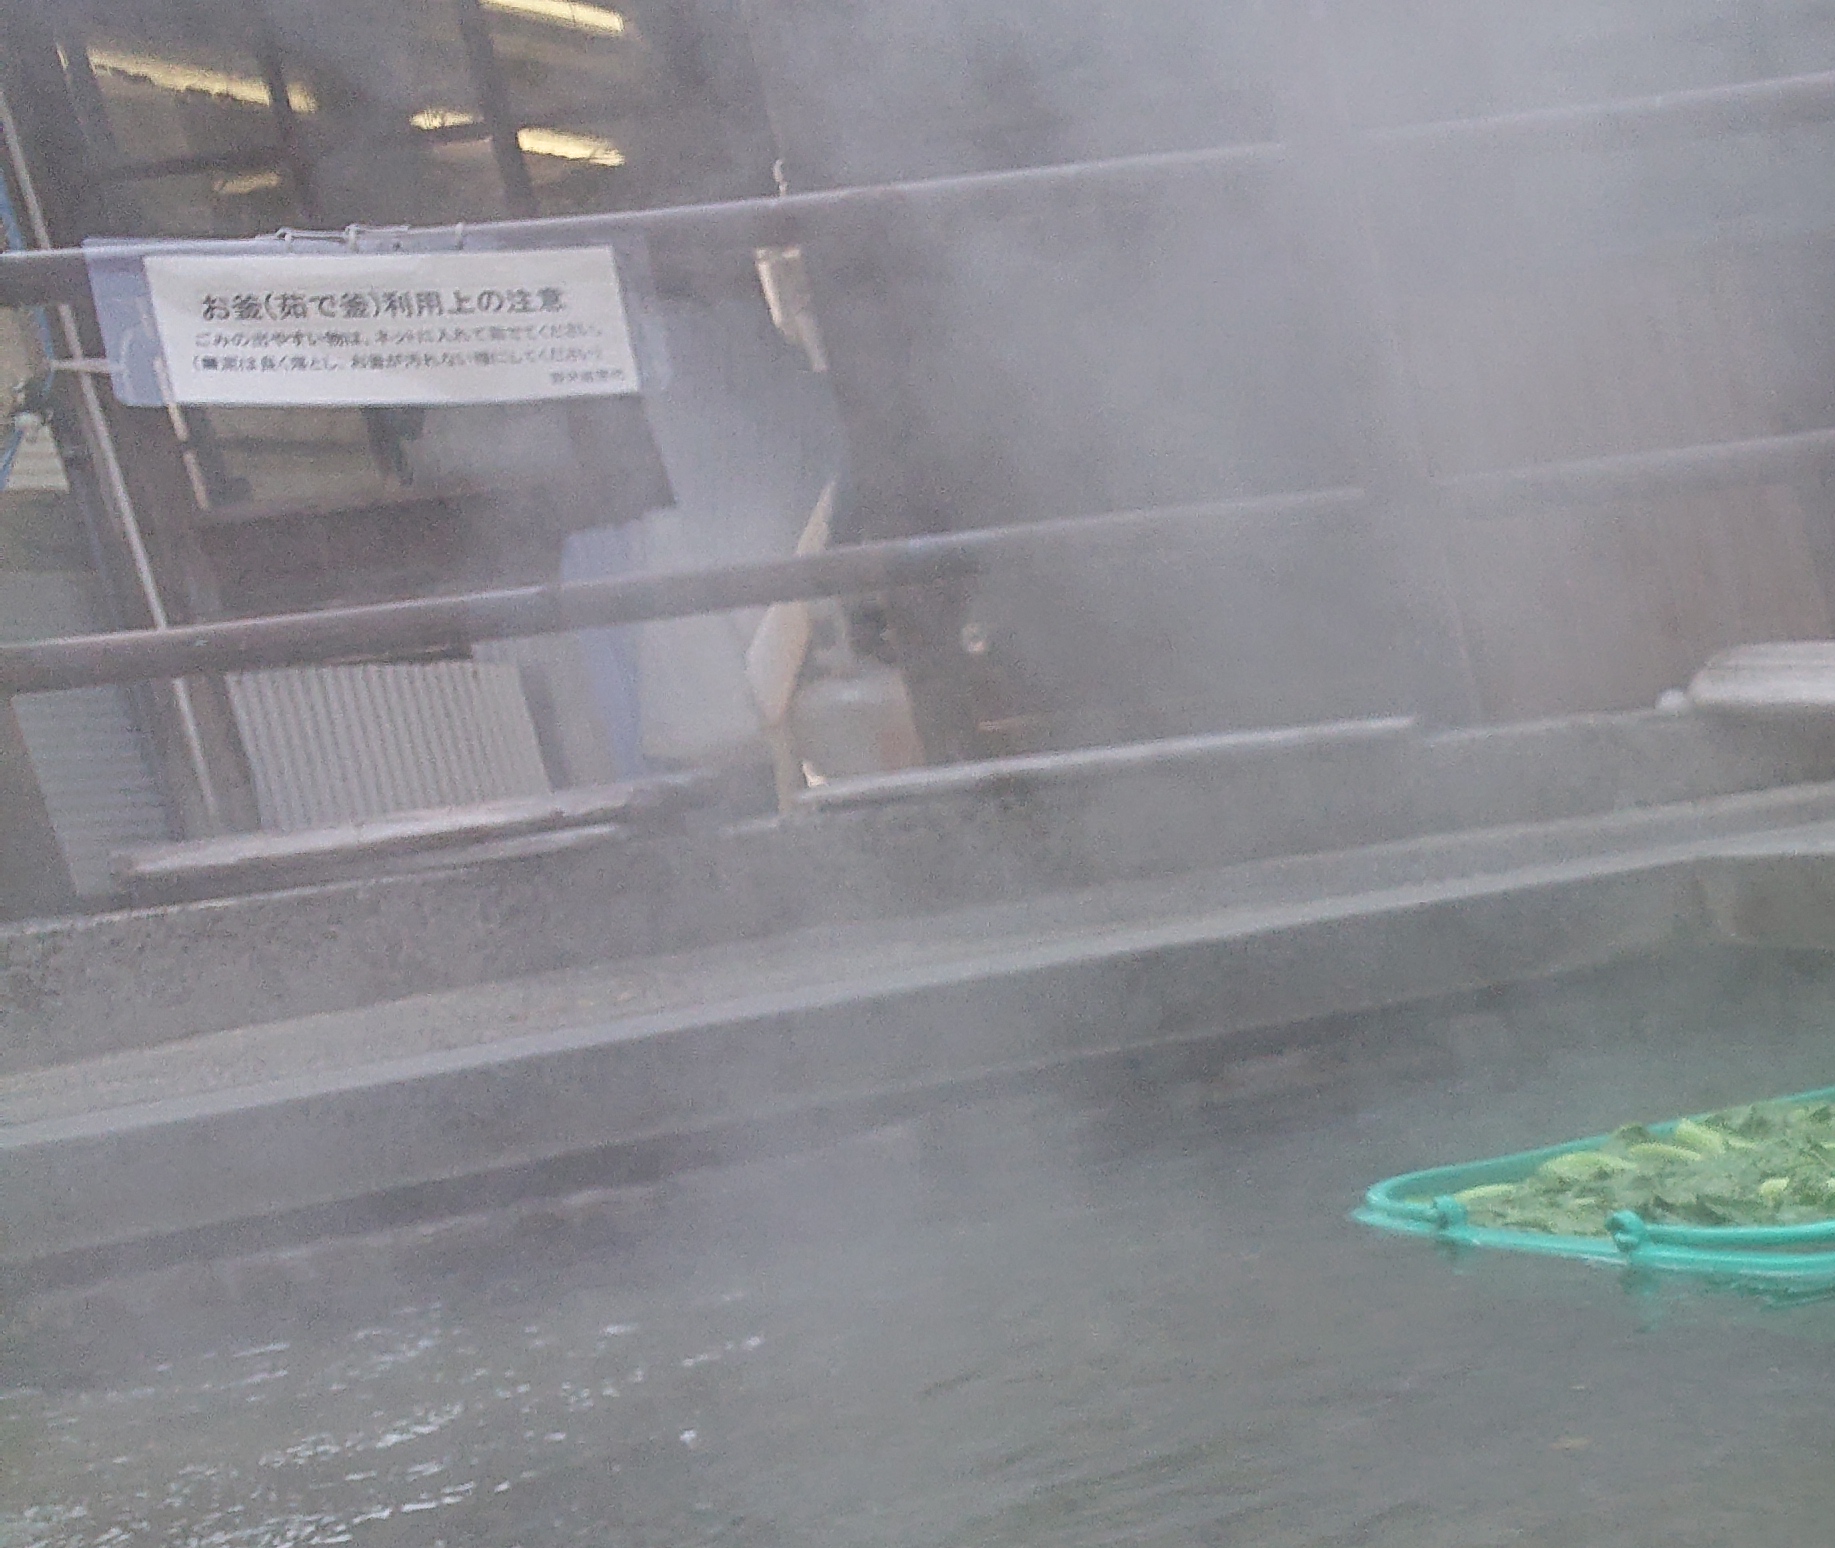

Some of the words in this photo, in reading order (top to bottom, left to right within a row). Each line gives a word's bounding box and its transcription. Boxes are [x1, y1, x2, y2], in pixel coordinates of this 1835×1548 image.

[202, 286, 565, 321] お釜(茹で釜)利用上の注意
